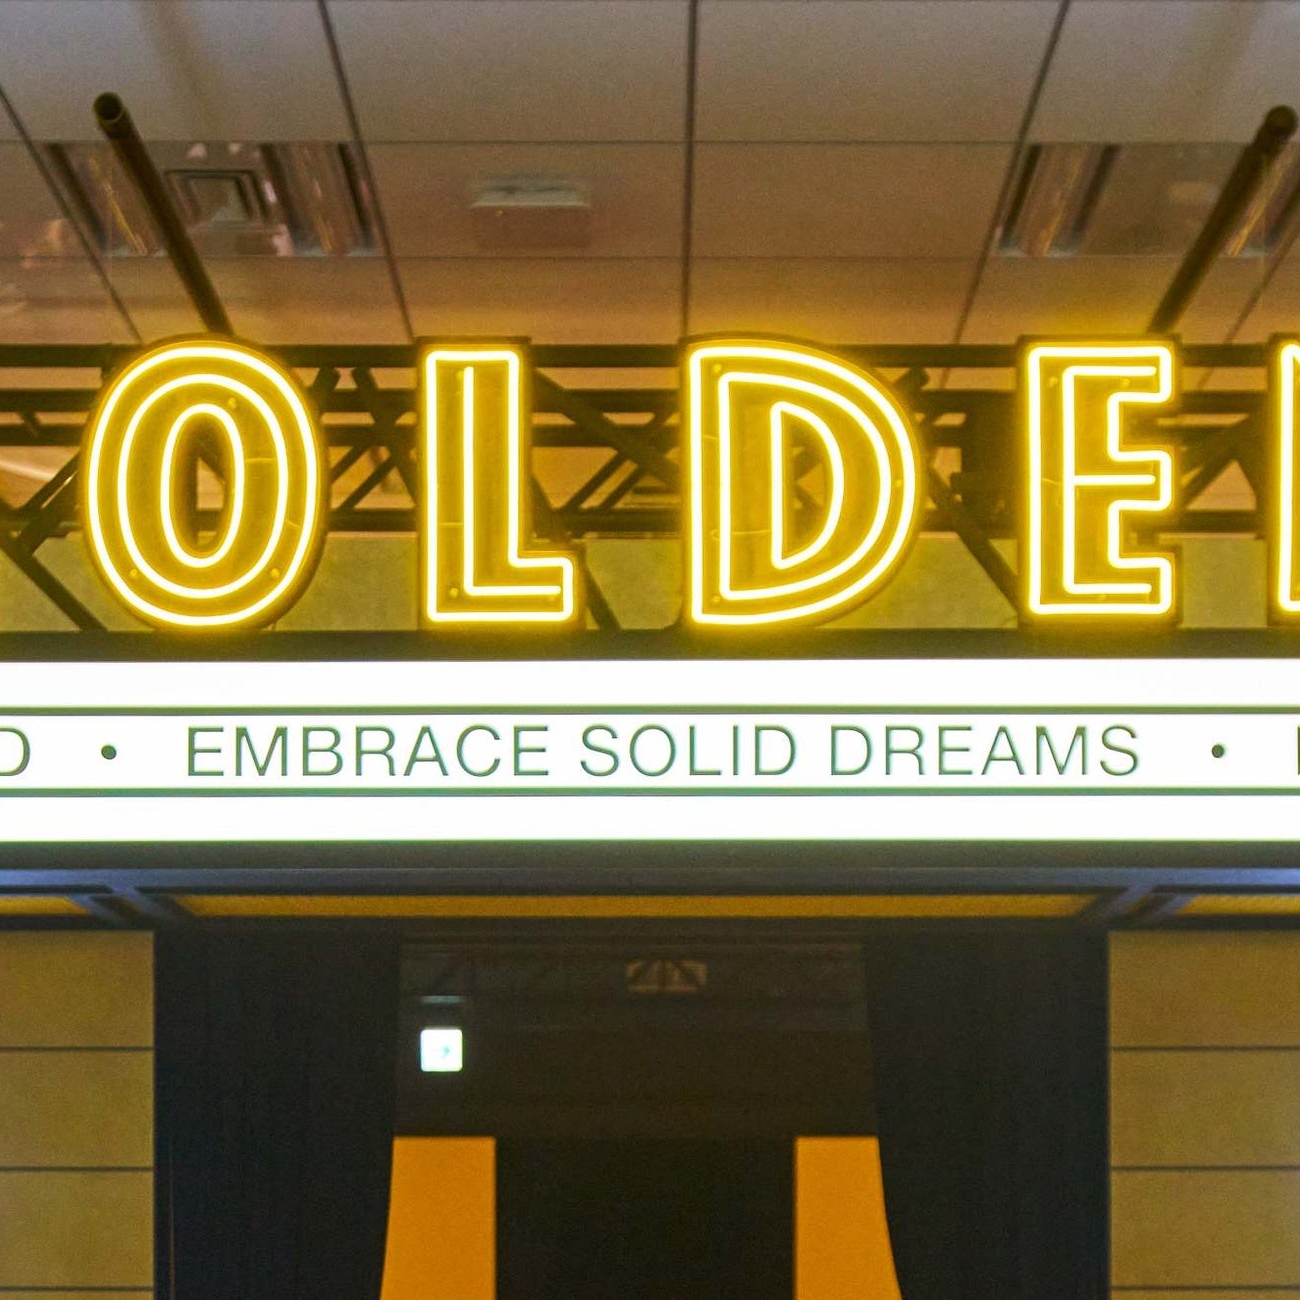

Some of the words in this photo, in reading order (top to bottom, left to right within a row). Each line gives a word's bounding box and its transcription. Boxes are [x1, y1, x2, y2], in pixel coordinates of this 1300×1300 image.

[186, 725, 550, 778] EMBRACE
[579, 725, 797, 778] SOLID
[829, 725, 1139, 777] DREAMS
